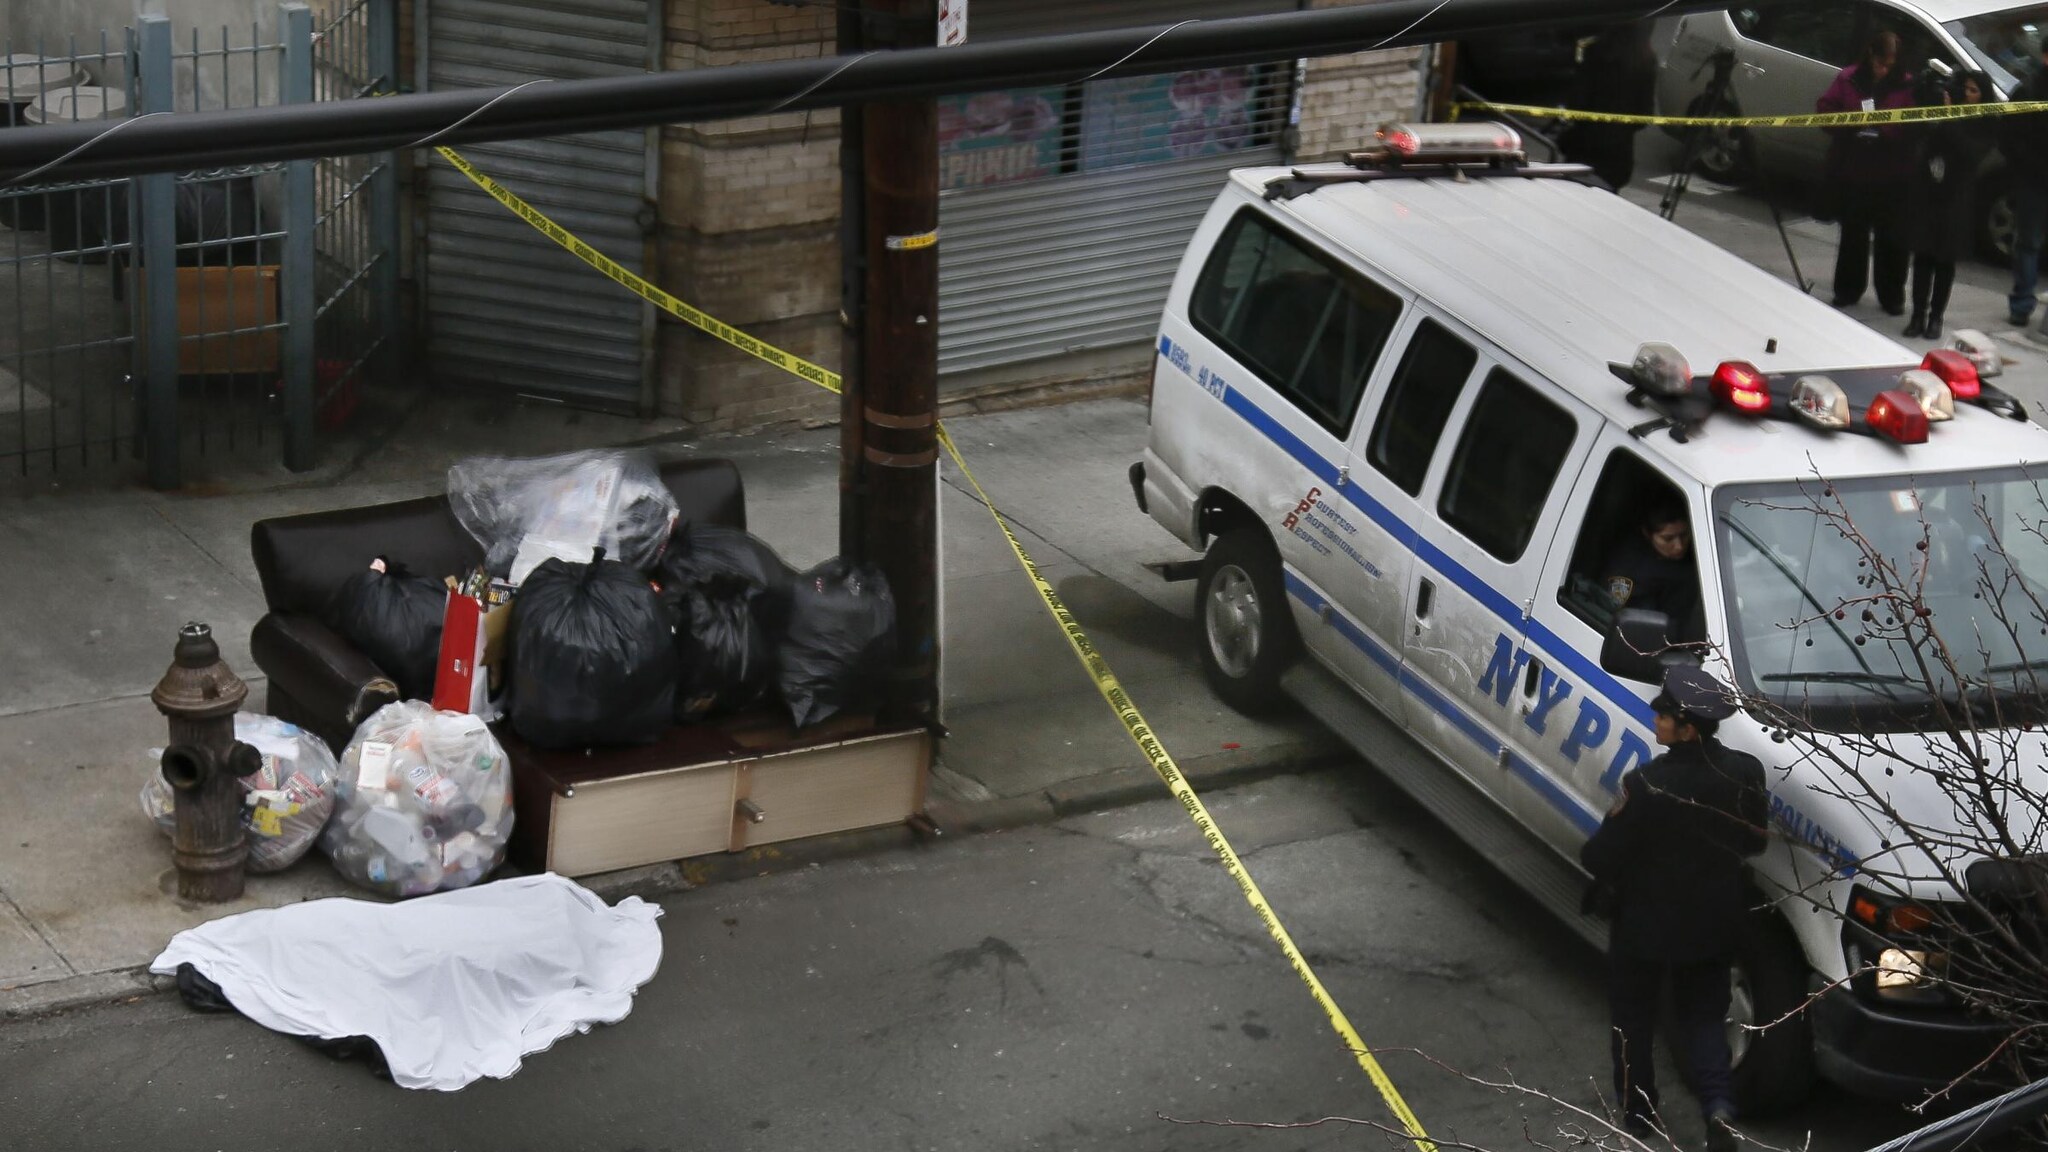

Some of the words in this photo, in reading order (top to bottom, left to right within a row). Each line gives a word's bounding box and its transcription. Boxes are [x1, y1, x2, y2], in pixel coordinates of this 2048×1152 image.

[1867, 111, 1892, 122] CROSS
[1281, 512, 1333, 556] RESPECT
[1306, 487, 1358, 535] COURTESY
[1478, 632, 1653, 796] NYPD
